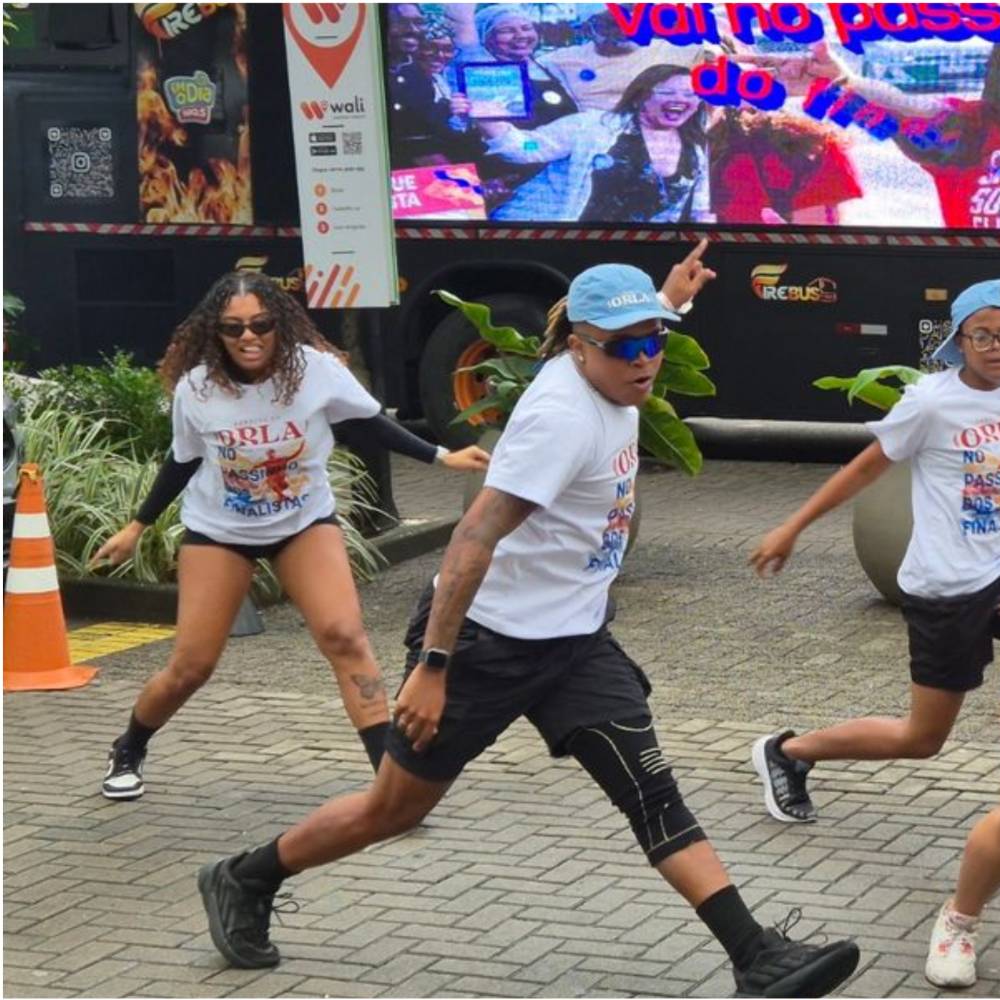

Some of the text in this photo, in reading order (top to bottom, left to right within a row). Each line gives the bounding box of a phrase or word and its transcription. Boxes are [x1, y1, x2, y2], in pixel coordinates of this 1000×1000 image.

[726, 3, 822, 43] no
[690, 55, 785, 109] do
[329, 95, 365, 113] wali
[963, 449, 985, 463] NO
